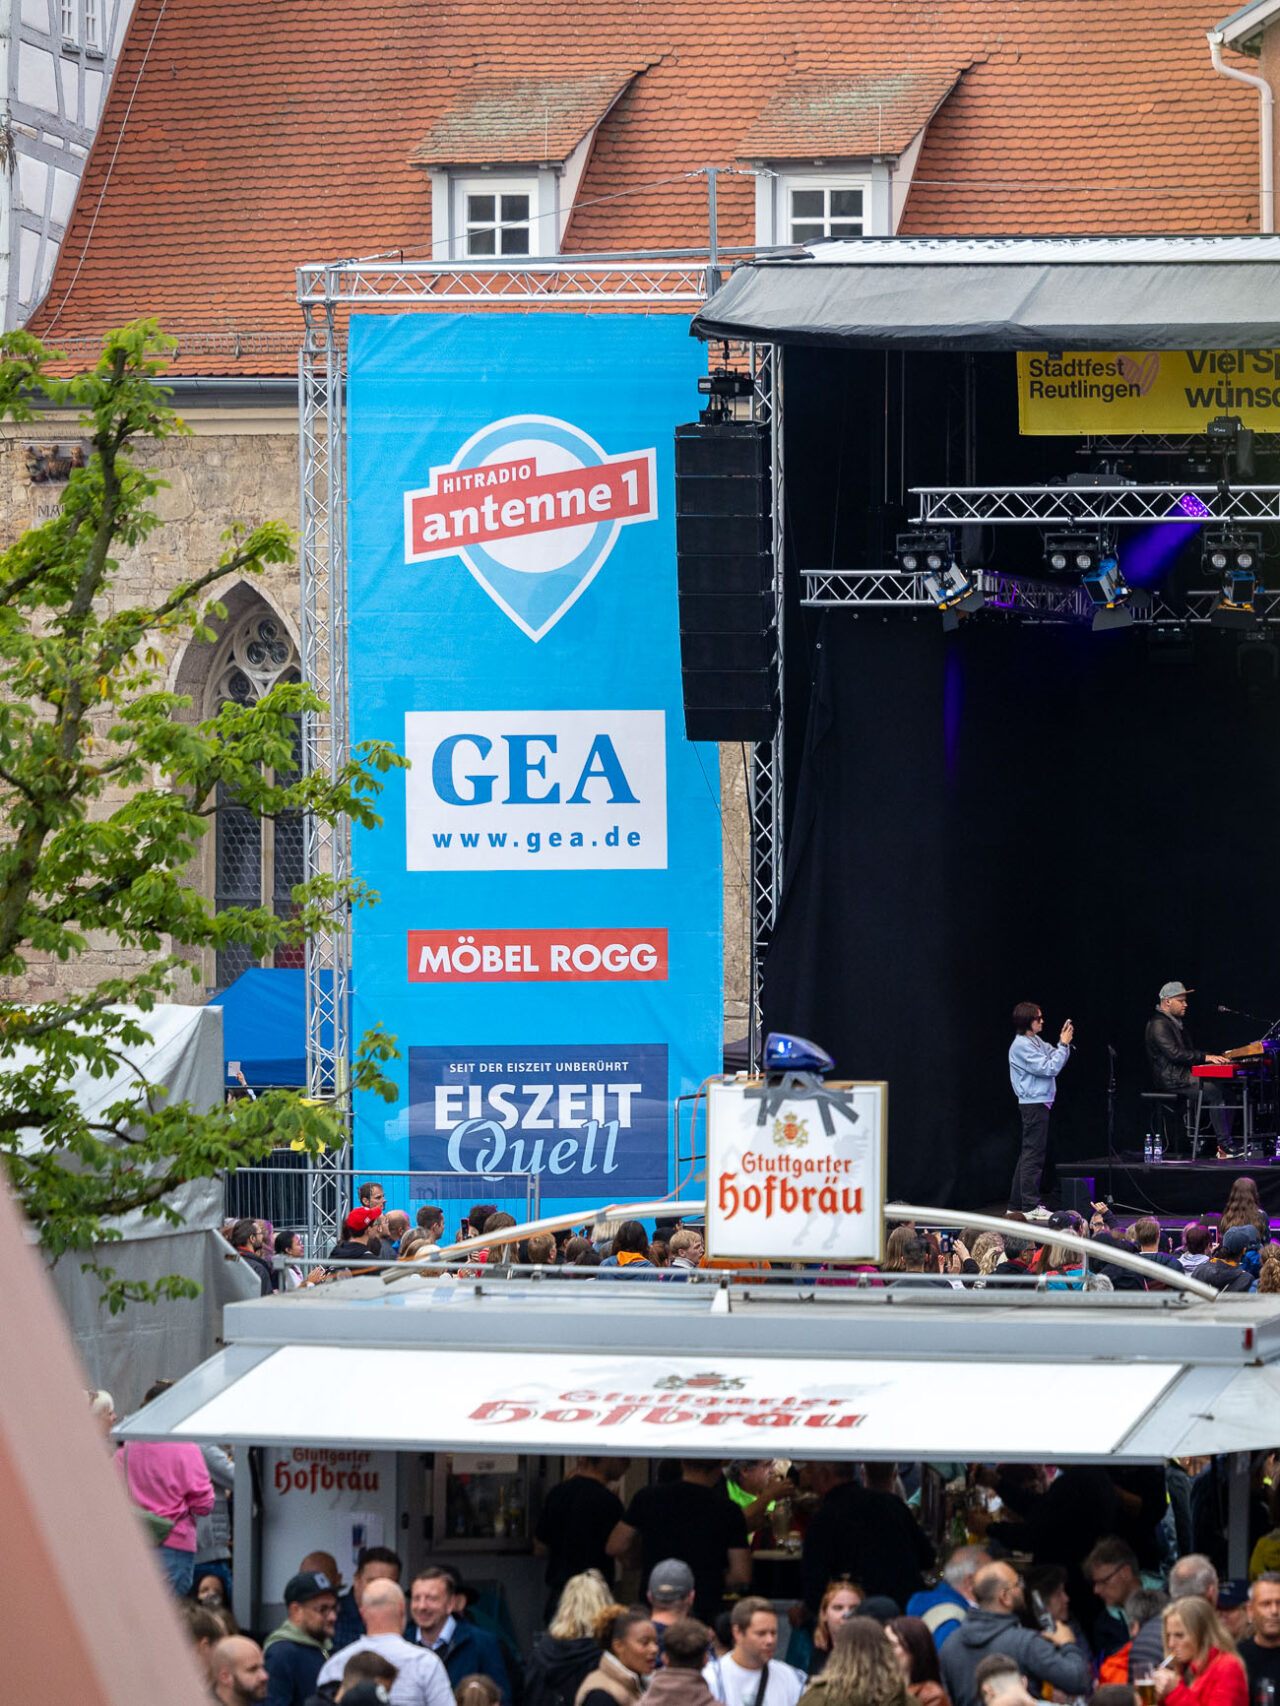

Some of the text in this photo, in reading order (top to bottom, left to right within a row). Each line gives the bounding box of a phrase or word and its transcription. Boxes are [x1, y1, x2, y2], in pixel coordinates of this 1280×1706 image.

[1029, 357, 1124, 377] Stadtfest
[1186, 348, 1244, 374] Viel
[1029, 380, 1141, 402] Reutlingen
[442, 464, 532, 494] HITRADIO
[422, 469, 639, 543] antenne 1
[431, 733, 641, 806] GEA
[432, 825, 642, 853] www.gea.de
[418, 936, 658, 973] MÖBEL ROGG
[450, 1060, 629, 1073] SEIT DER EISZEIT UNBERÜHRT
[434, 1083, 642, 1130] EISZEIT
[447, 1117, 620, 1181] Quell
[741, 1151, 853, 1179] Stuttgarter
[558, 1389, 850, 1408] Stuttgarter
[292, 1447, 371, 1466] Stuttgarter
